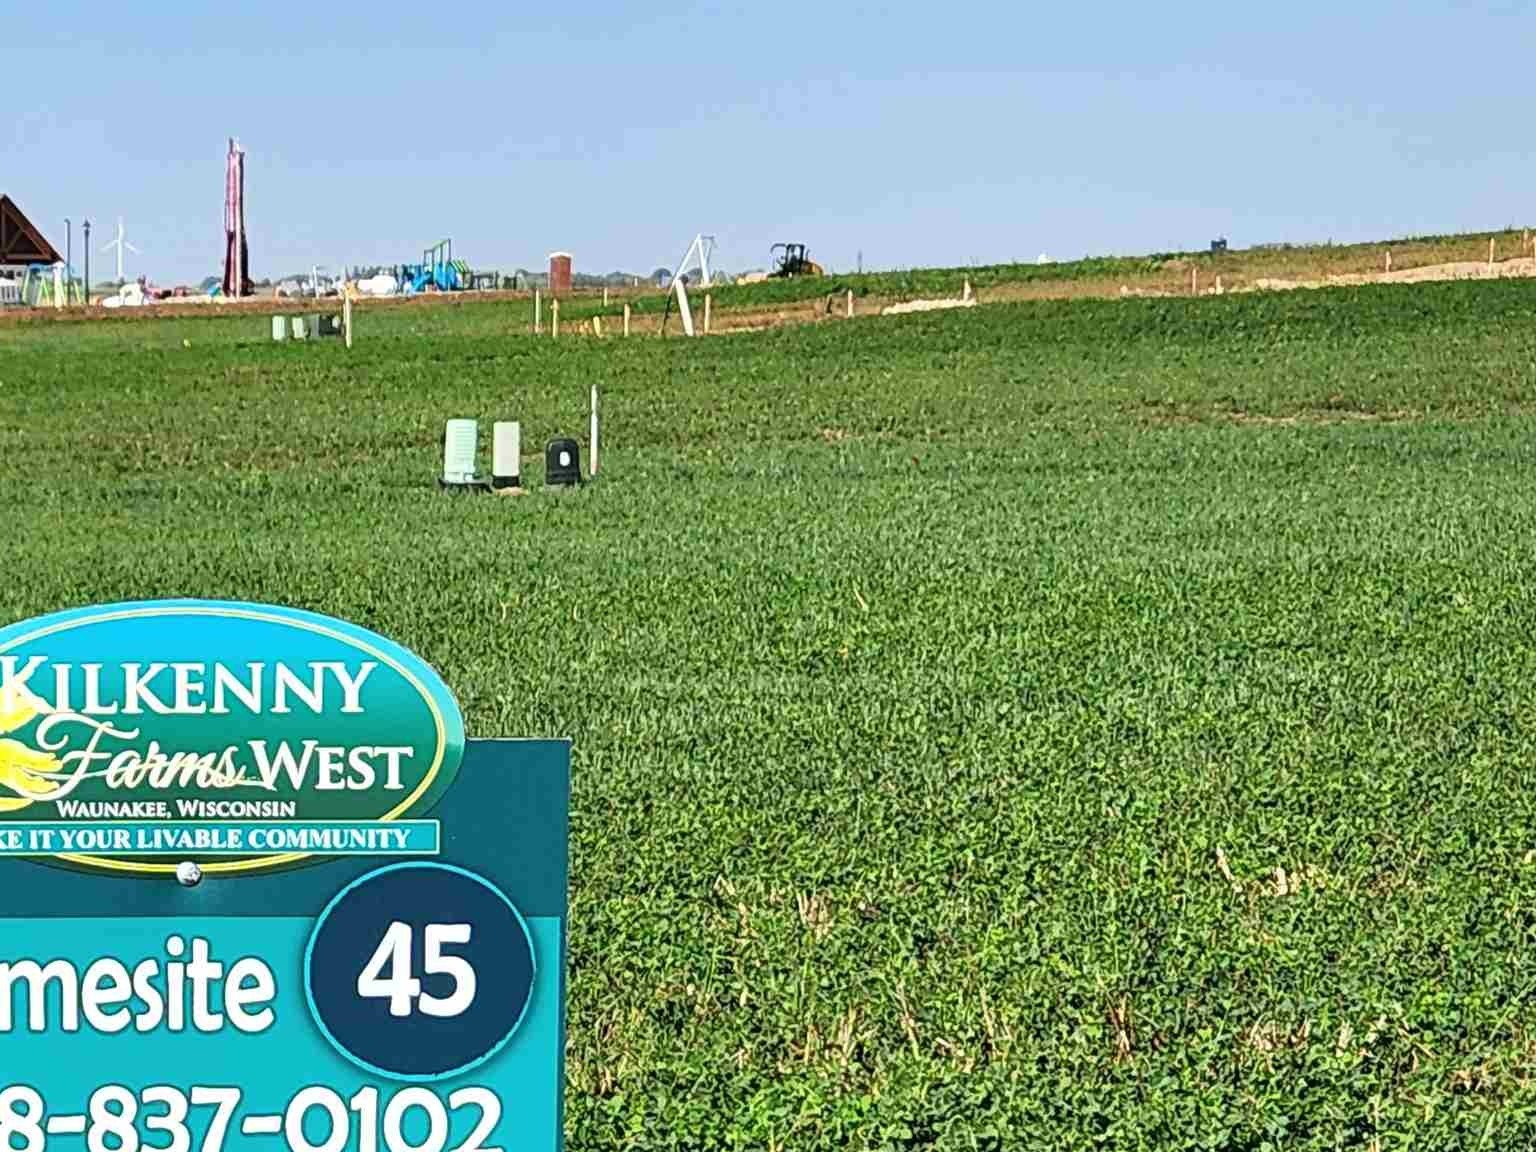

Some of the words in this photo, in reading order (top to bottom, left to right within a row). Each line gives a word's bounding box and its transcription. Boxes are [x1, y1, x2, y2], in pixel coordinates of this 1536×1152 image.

[35, 712, 249, 797] Farms
[247, 739, 413, 791] WEST
[57, 801, 172, 818] WAUNAKEE,
[177, 800, 296, 818] WISCONSIN
[28, 830, 53, 849] IT
[61, 830, 131, 850] YOUR
[138, 829, 242, 849] LIVABLE
[249, 829, 411, 849] COMMUNITY
[357, 922, 475, 1017] 45
